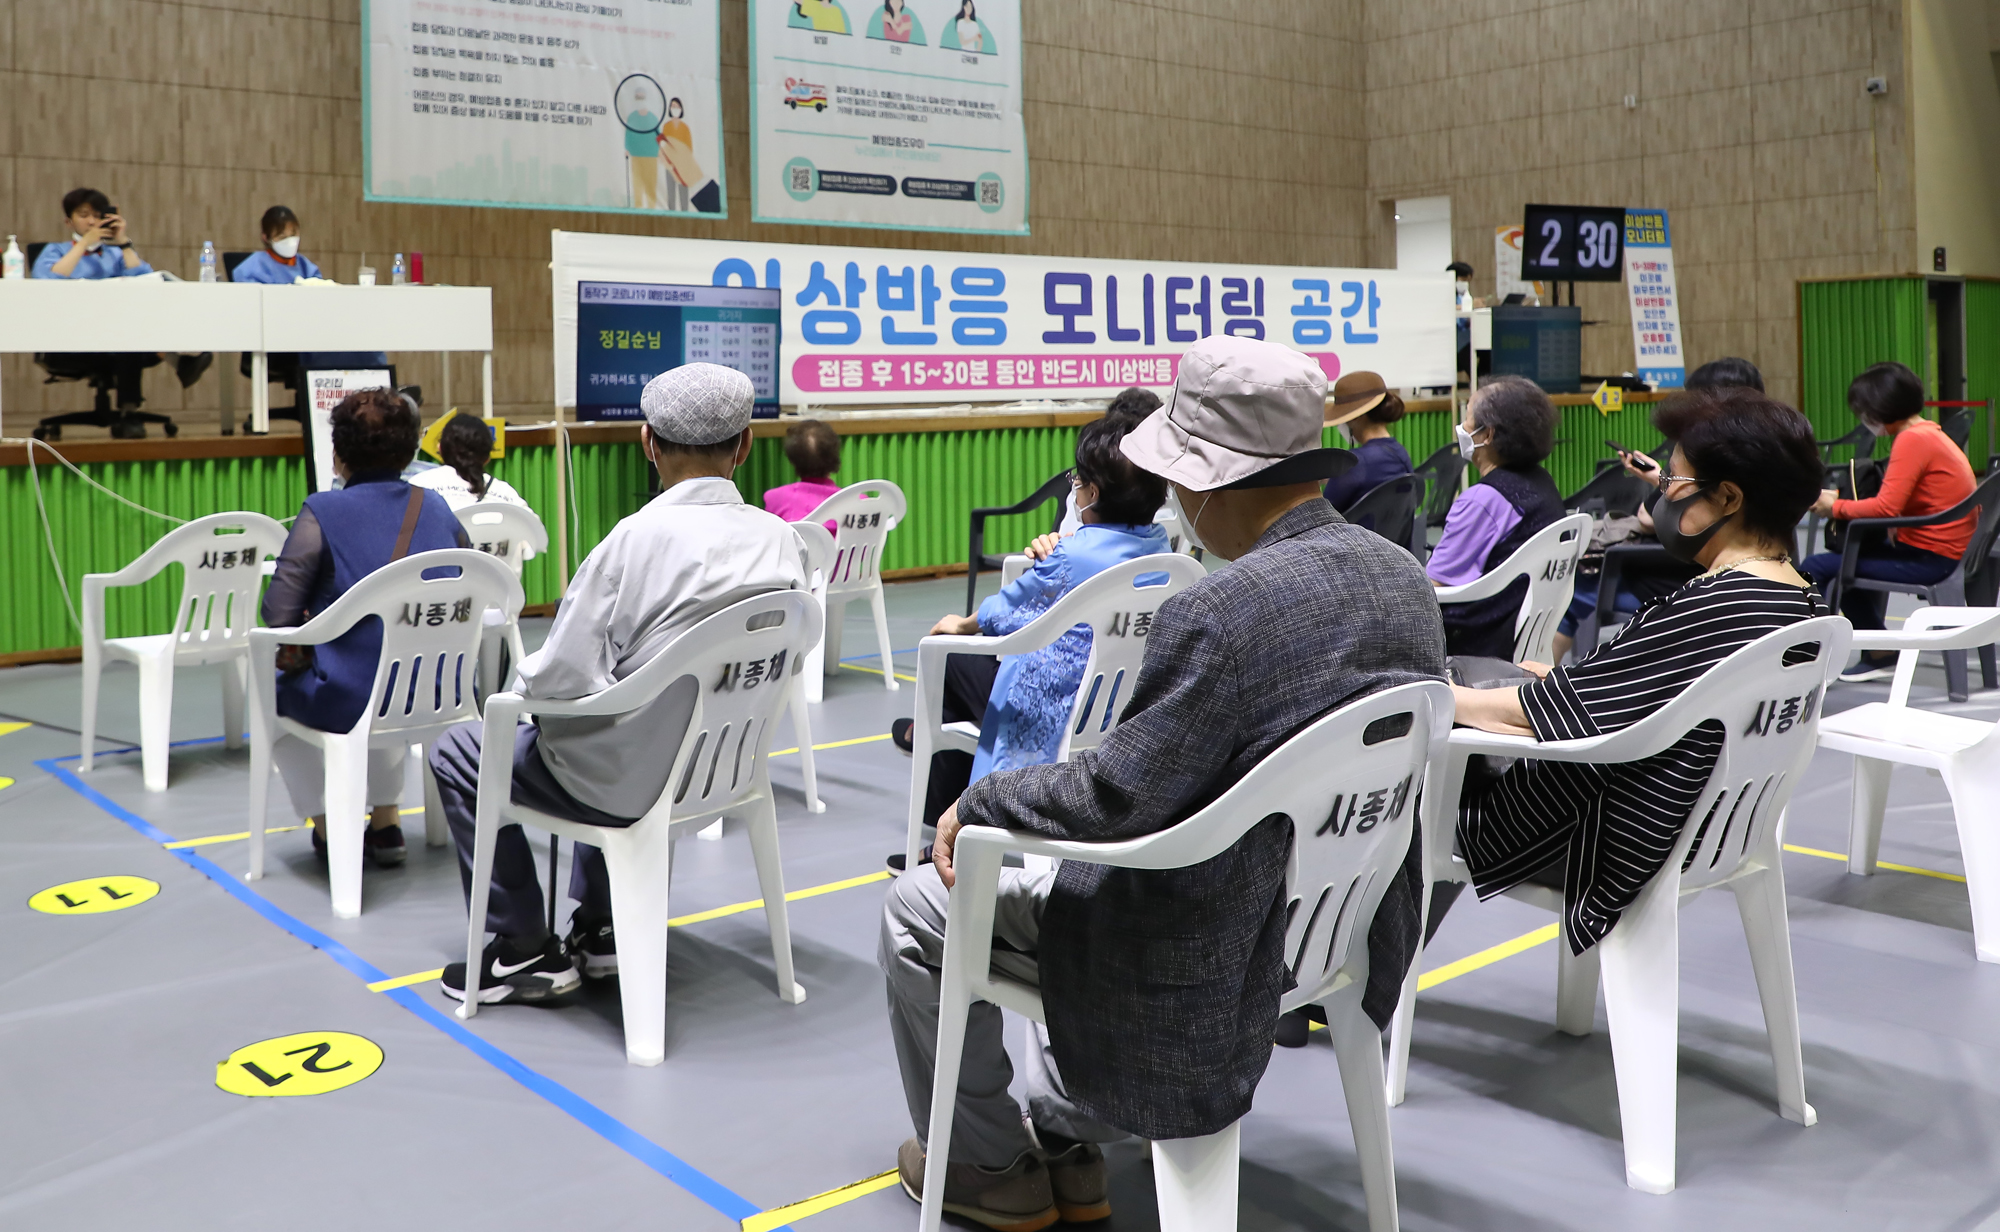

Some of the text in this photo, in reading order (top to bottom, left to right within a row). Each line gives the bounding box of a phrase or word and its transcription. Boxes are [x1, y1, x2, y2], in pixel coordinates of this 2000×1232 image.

[1540, 219, 1618, 269] 2 30
[1042, 272, 1265, 346] 모니터링
[1290, 278, 1381, 345] 공간
[599, 329, 662, 350] 정길순님
[818, 357, 1172, 388] 접종 후 15~30분 동안 반드시 이상반응
[841, 512, 881, 529] 사종체
[199, 546, 257, 571] 사종체
[396, 597, 473, 627] 사종체
[1105, 611, 1154, 638] 사종
[714, 649, 787, 693] 사종체
[1743, 684, 1822, 738] 사종체
[1315, 772, 1414, 838] 사종체
[55, 886, 133, 908] 11
[240, 1042, 353, 1087] 21
